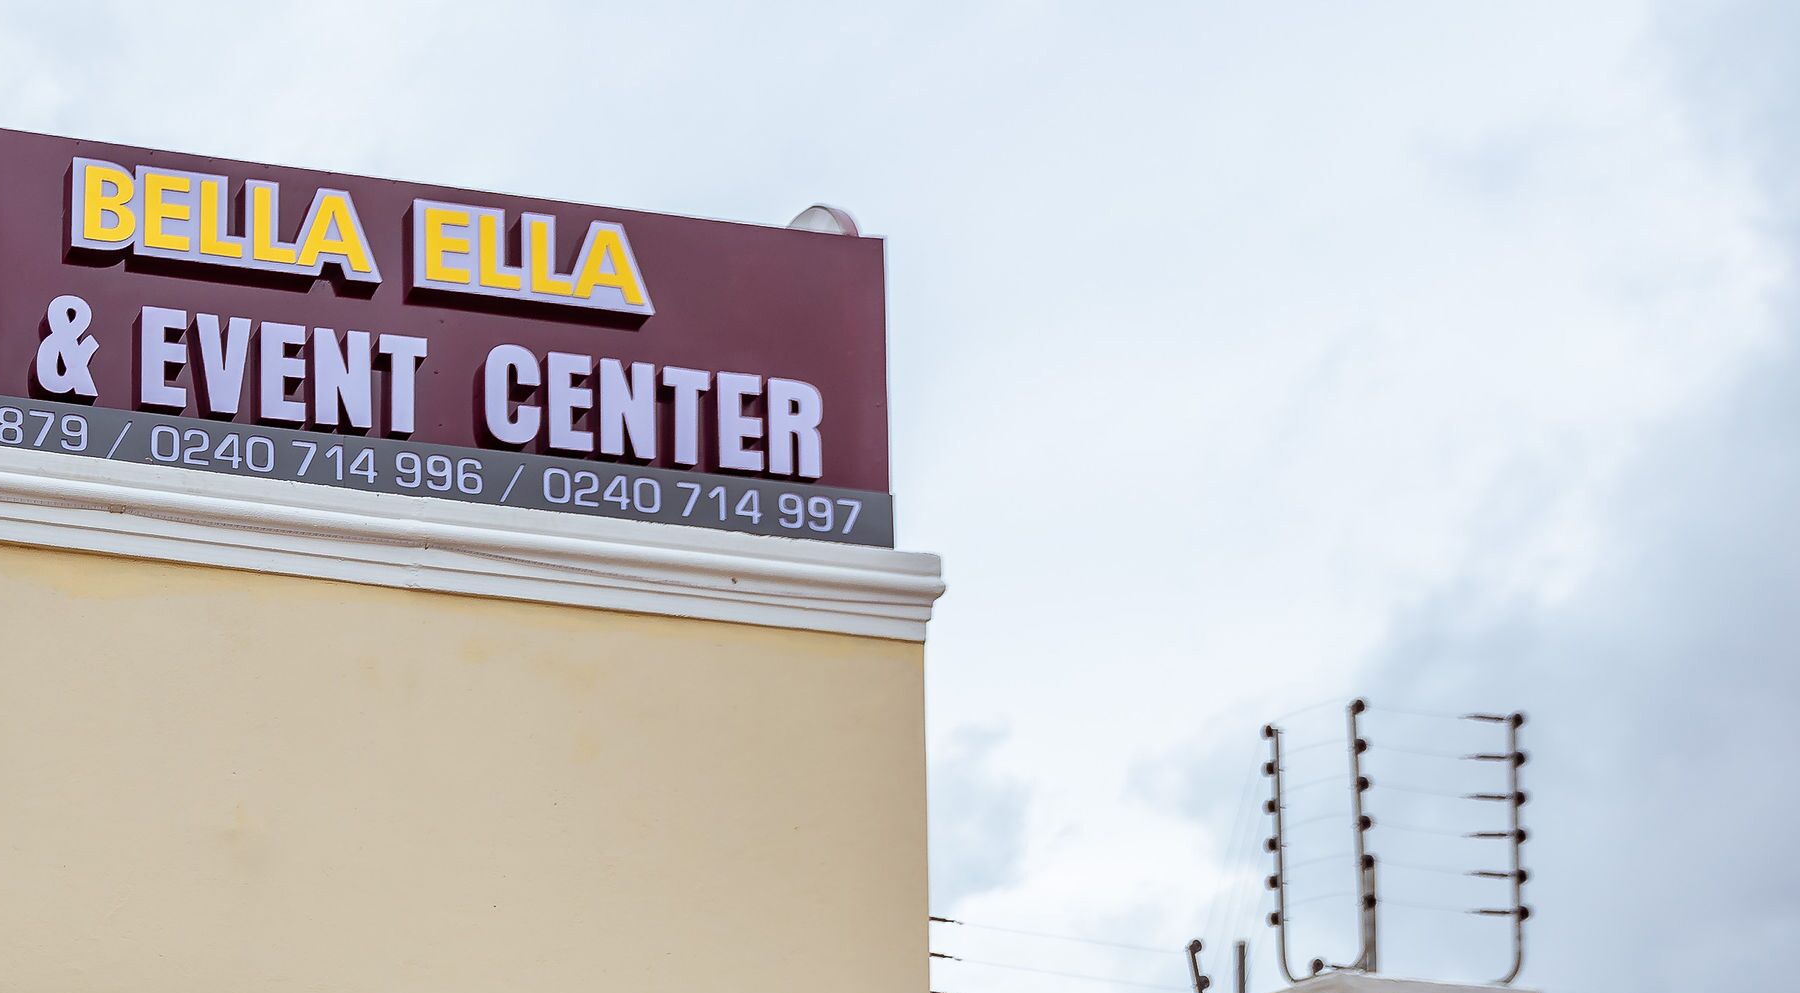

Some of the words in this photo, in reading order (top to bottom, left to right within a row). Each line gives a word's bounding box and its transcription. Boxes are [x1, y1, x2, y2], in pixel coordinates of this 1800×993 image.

[71, 157, 383, 284] BELLA
[413, 198, 656, 316] ELLA
[36, 295, 99, 398] &
[141, 306, 428, 434] EVENT
[484, 343, 823, 479] CENTER
[150, 425, 276, 473] 0240
[292, 440, 377, 481] 714
[395, 454, 484, 495] 996
[543, 467, 662, 513] 0240
[676, 481, 762, 525] 714
[778, 493, 862, 534] 997
